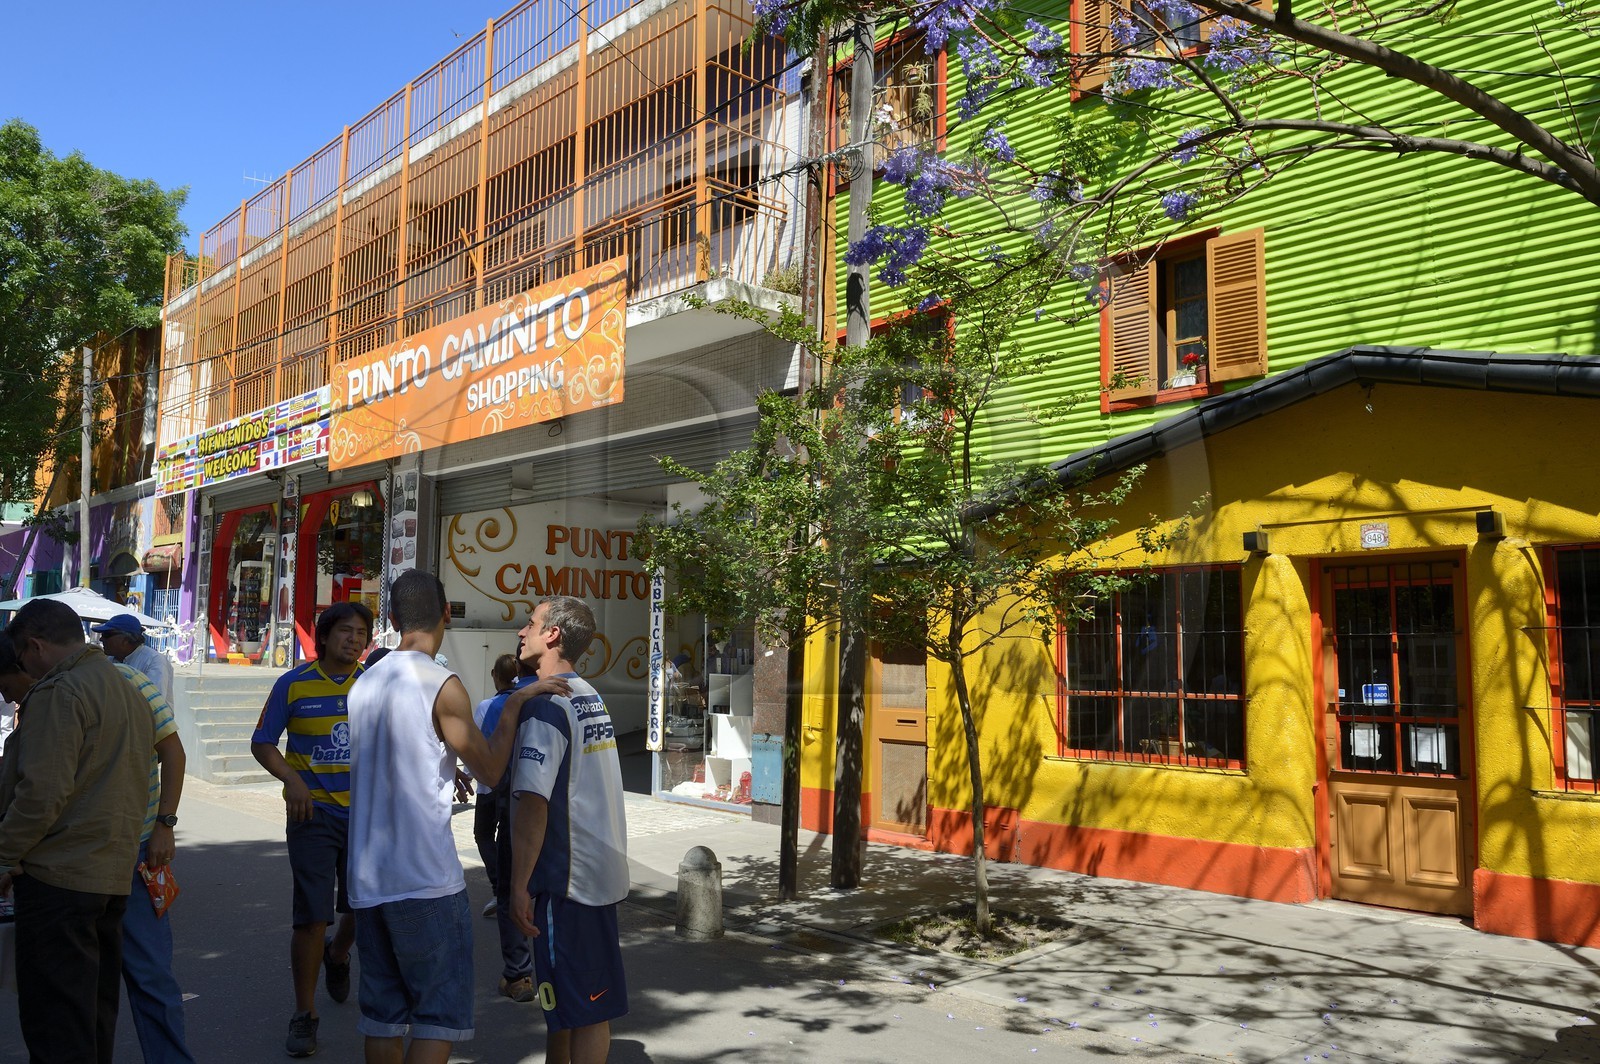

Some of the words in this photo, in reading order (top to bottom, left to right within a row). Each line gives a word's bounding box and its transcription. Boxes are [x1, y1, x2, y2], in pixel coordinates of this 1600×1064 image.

[347, 344, 431, 411] PUNTO
[441, 286, 590, 381] CAMINITO
[466, 356, 564, 412] SHOPPING
[197, 416, 270, 459] BIENVENIDOS
[203, 446, 259, 480] WELCOME
[1366, 533, 1383, 544] 848
[495, 563, 651, 601] CAMINITO
[651, 563, 663, 653] ABRICA
[649, 676, 661, 743] CUERO
[582, 721, 616, 744] PPS
